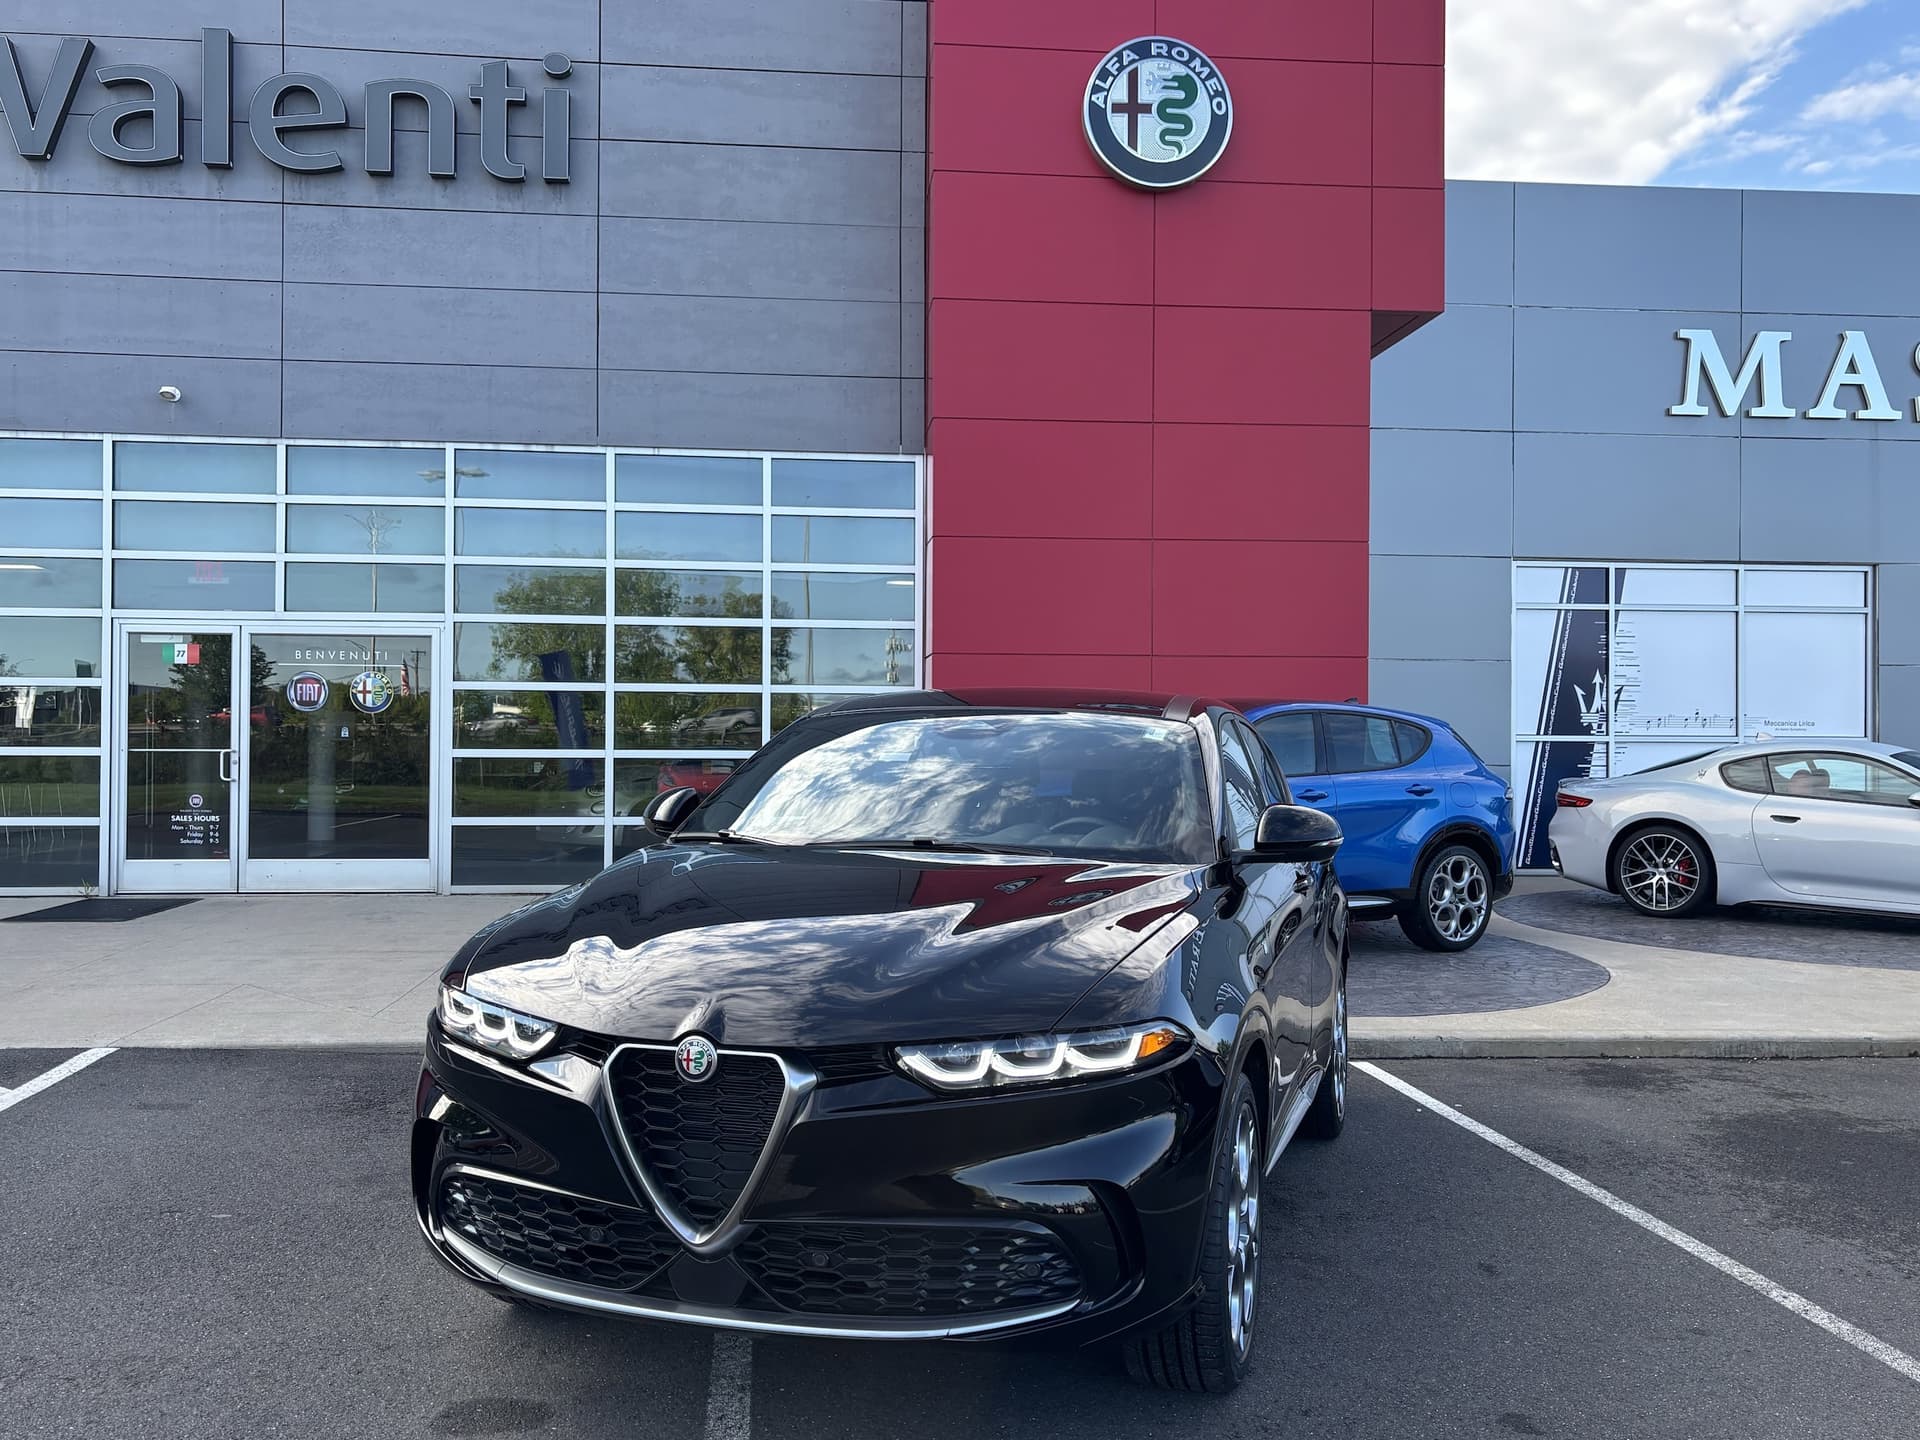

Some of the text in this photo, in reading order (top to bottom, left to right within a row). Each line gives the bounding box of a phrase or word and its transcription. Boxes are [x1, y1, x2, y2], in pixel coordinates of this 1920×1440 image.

[0, 26, 574, 184] Valenti
[1091, 42, 1227, 115] ALFA ROMEO
[1668, 328, 1920, 422] MA
[295, 650, 388, 660] BENVENUTI
[296, 683, 321, 701] FIAT
